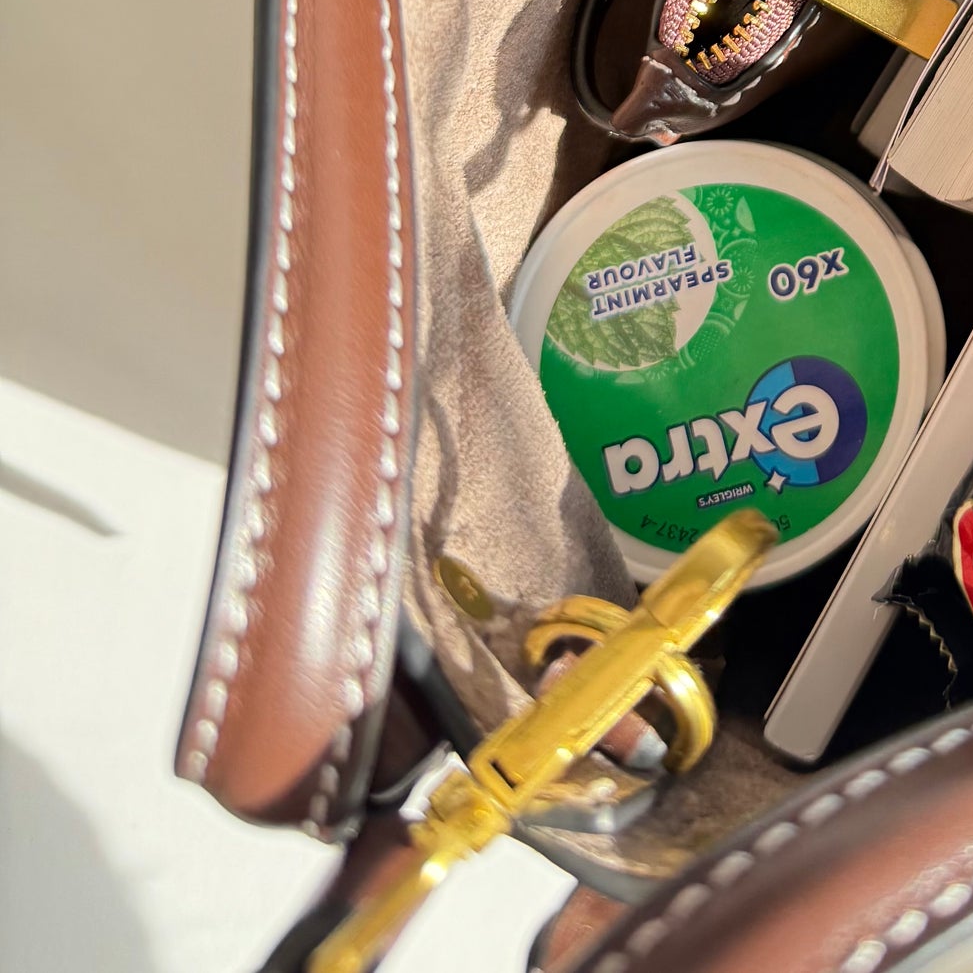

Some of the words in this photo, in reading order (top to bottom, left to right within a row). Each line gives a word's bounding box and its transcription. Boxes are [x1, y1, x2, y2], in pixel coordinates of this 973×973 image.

[587, 244, 698, 290] FLAVOUR
[592, 260, 731, 317] SPEARMINT
[770, 249, 846, 300] x60
[602, 383, 841, 496] extra
[698, 484, 753, 507] WRIGLEY'S
